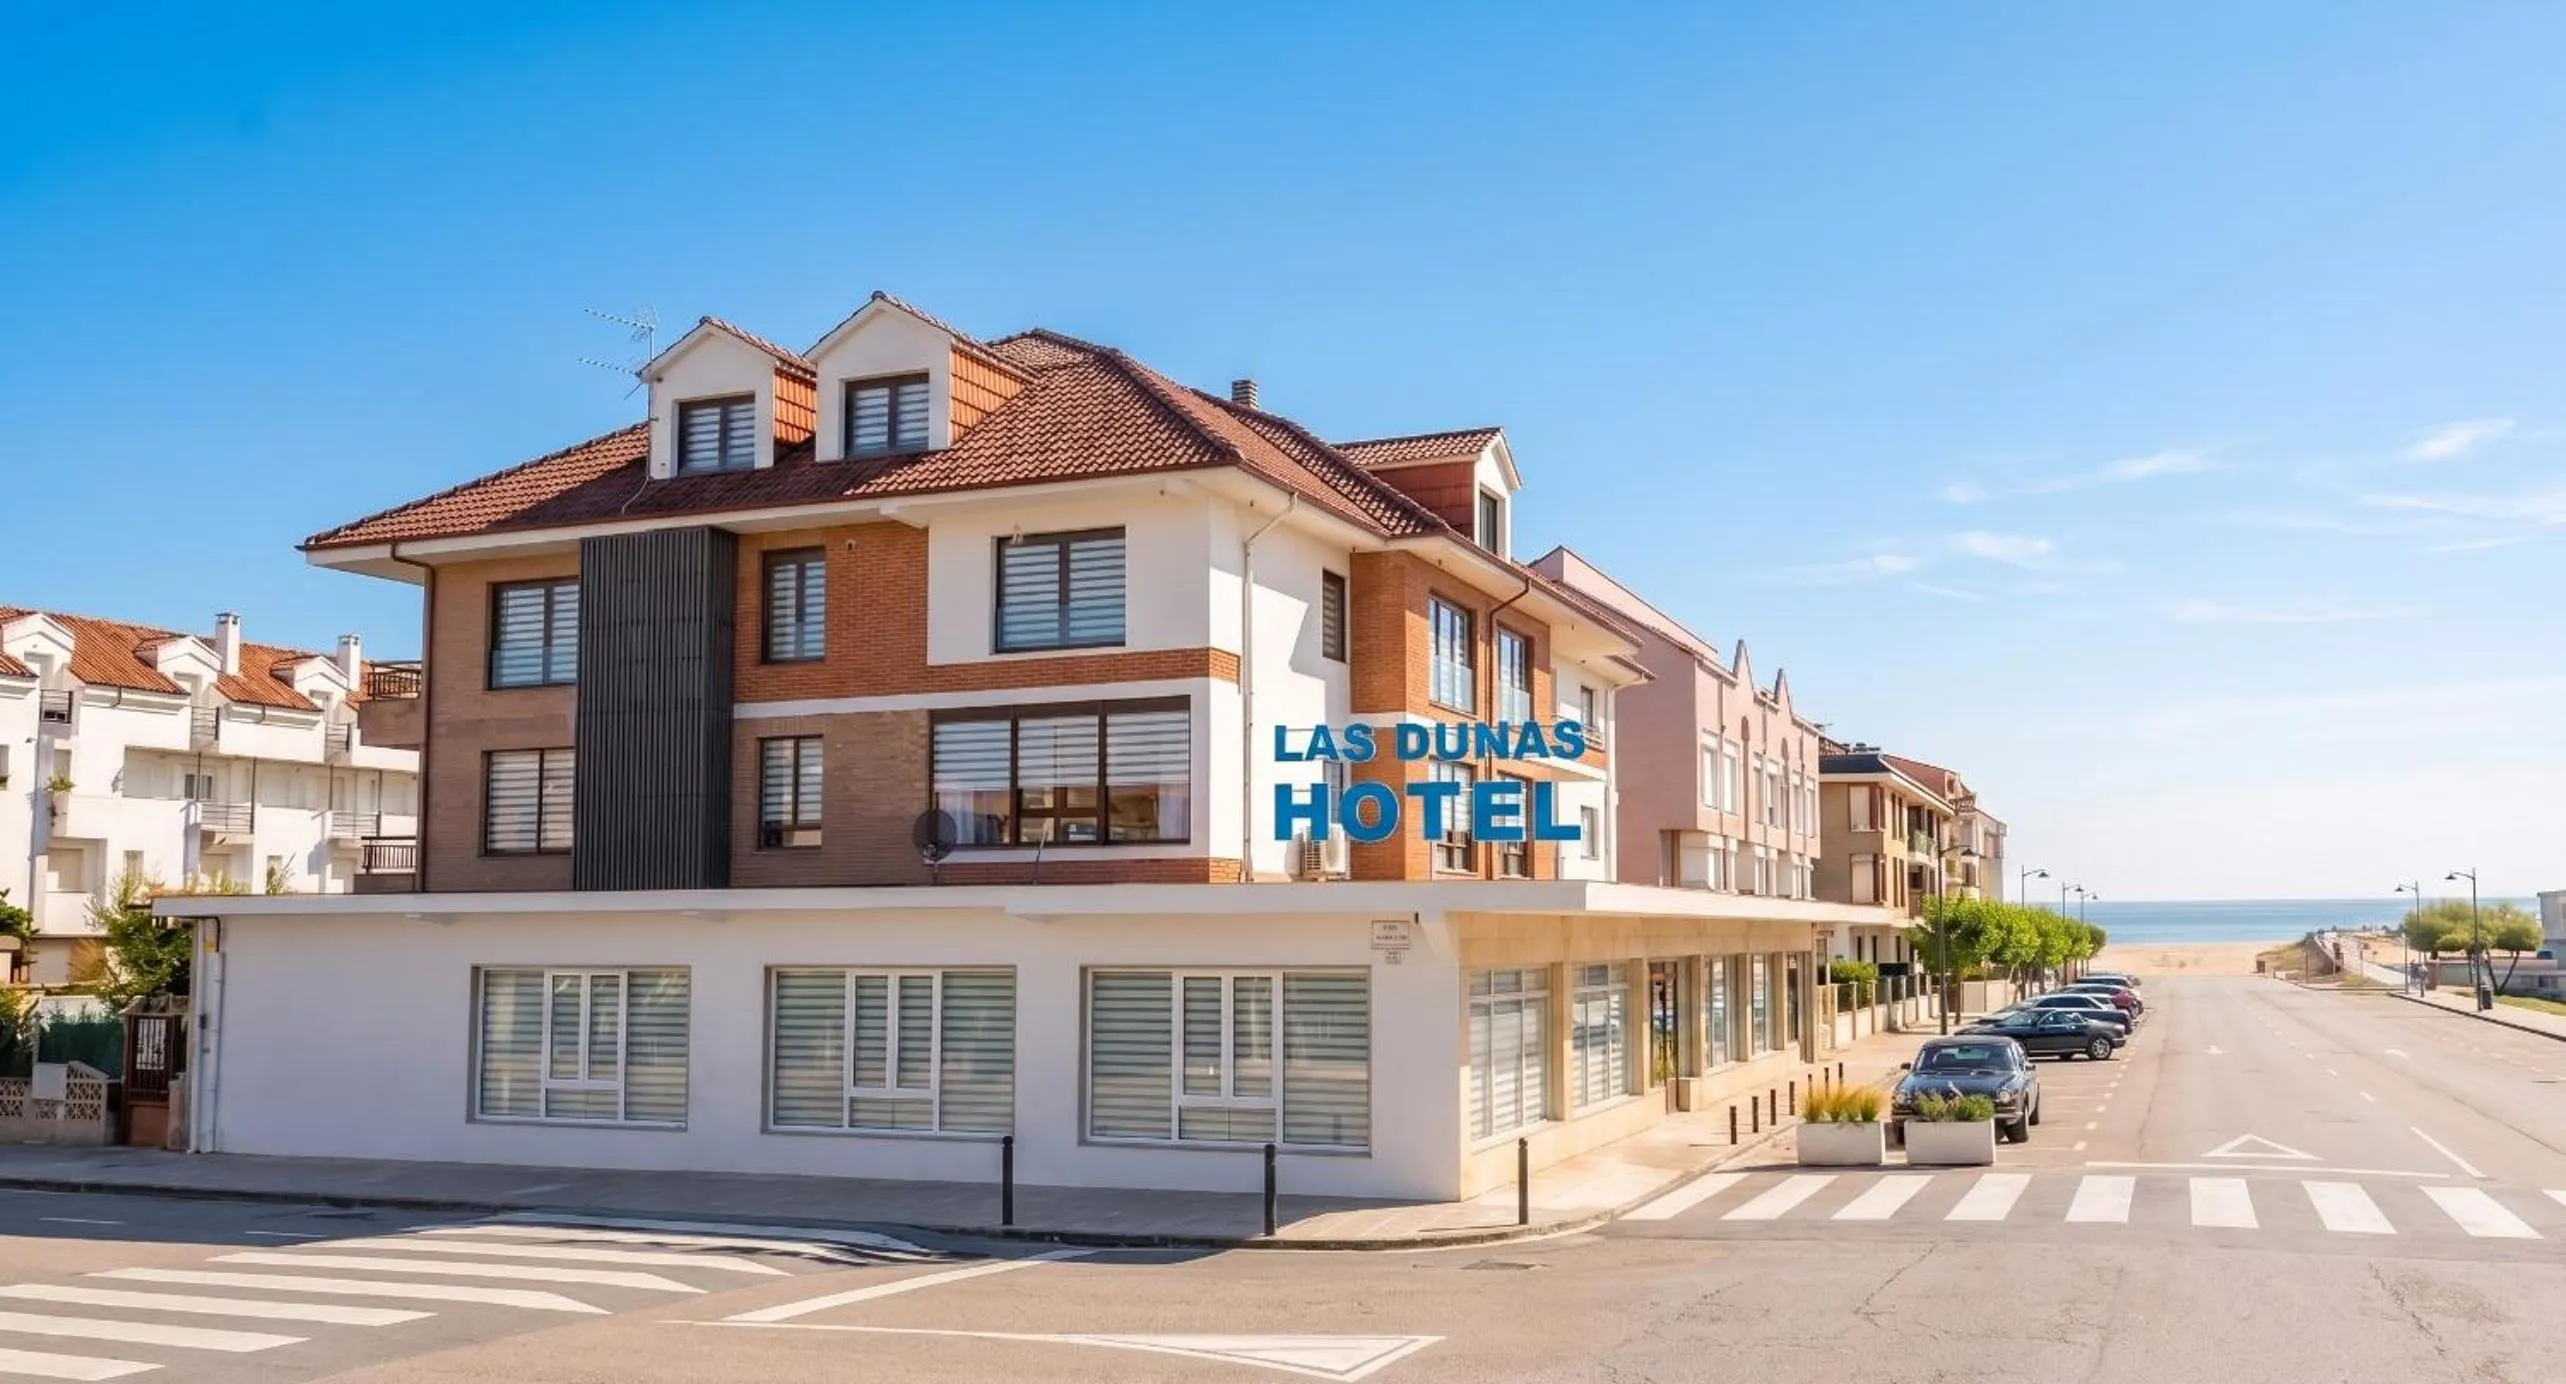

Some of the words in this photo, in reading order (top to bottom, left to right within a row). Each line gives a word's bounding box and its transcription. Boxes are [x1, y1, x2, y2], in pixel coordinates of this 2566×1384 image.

[1274, 723, 1376, 762] LAS
[1396, 720, 1586, 761] DUNAS
[1274, 780, 1581, 843] HOTEL
